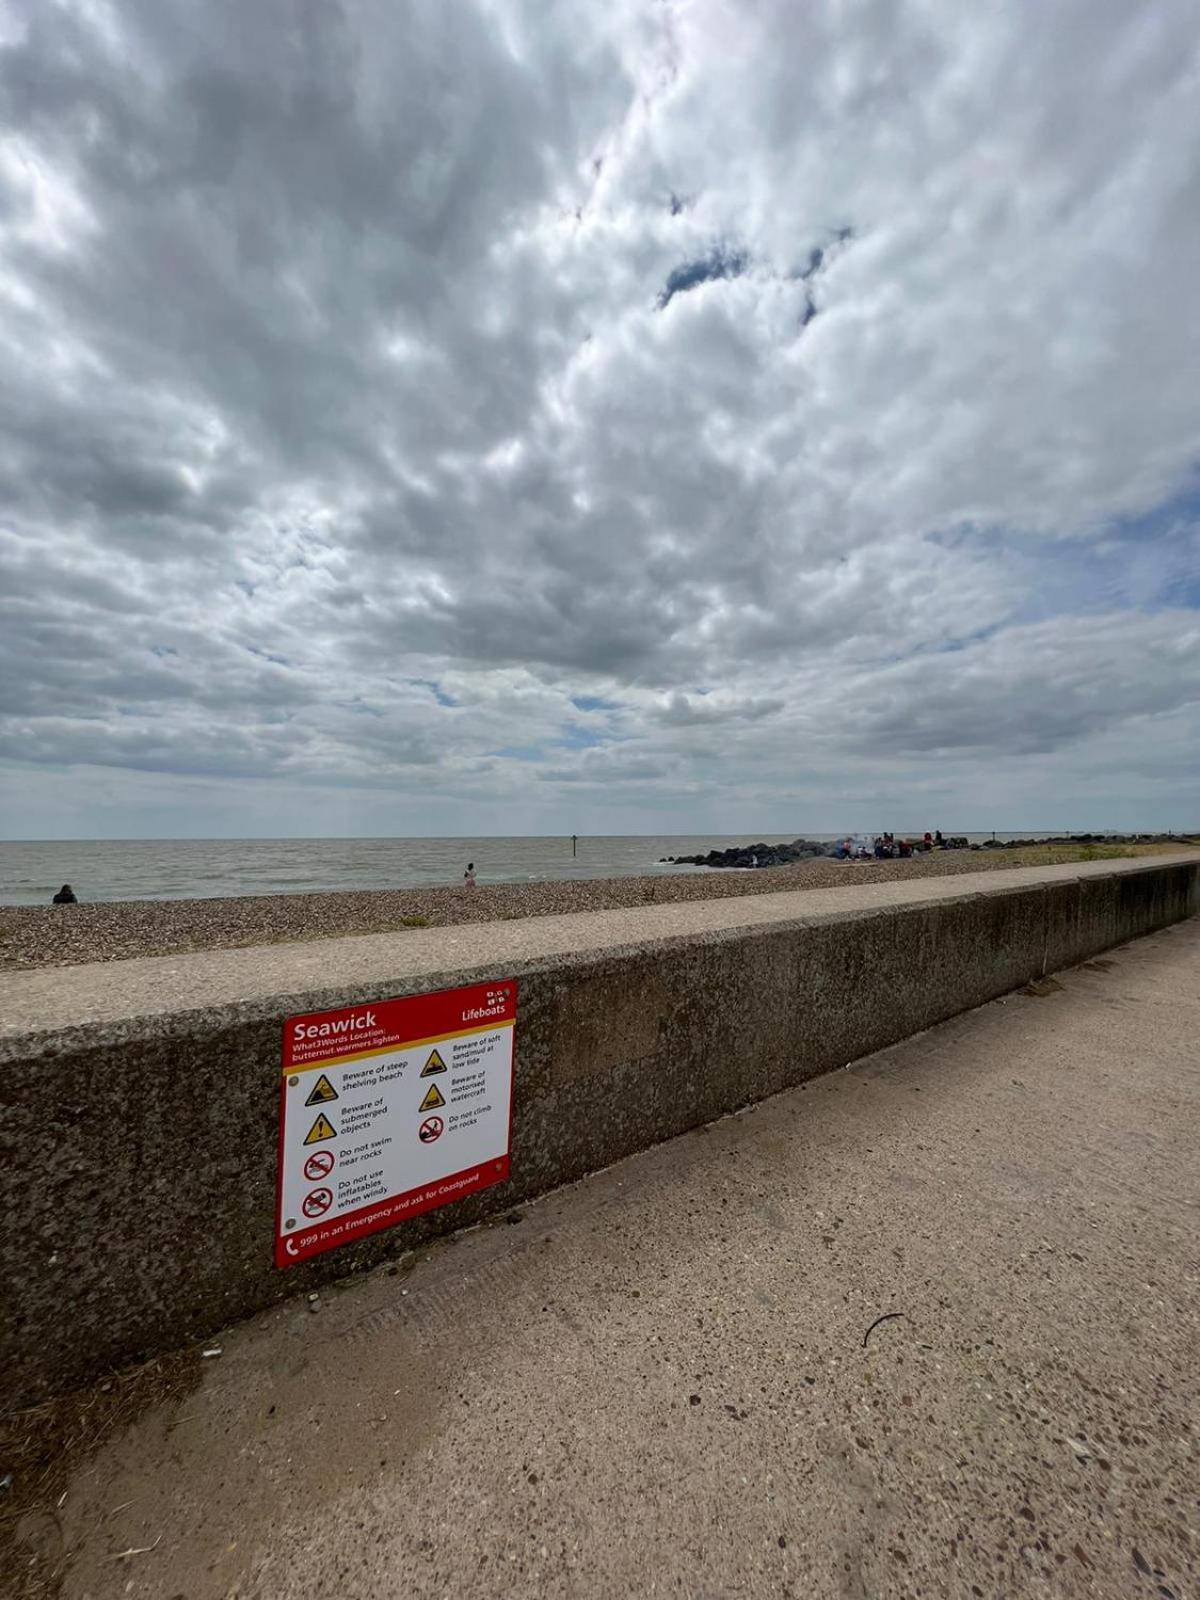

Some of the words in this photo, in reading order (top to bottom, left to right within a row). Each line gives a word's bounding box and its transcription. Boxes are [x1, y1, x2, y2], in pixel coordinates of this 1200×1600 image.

[462, 1005, 505, 1021] Lifeboats
[294, 1011, 376, 1040] Seawick
[293, 1035, 348, 1052] What3Words
[453, 1041, 478, 1051] Beware
[479, 1038, 487, 1046] of
[343, 1069, 374, 1081] Beware
[375, 1064, 384, 1073] of
[387, 1061, 408, 1071] steep
[452, 1074, 476, 1085] Beware
[478, 1070, 486, 1078] of
[342, 1078, 377, 1091] shelving
[379, 1070, 403, 1082] beach
[341, 1102, 372, 1115] Beware
[374, 1097, 383, 1106] of
[460, 1110, 473, 1119] not
[473, 1104, 492, 1115] climb
[341, 1106, 388, 1125] submerged
[459, 1118, 477, 1128] rocks
[340, 1121, 371, 1134] objects
[340, 1150, 352, 1158] Do
[354, 1144, 368, 1153] not
[370, 1137, 392, 1148] swim
[339, 1157, 358, 1167] near
[360, 1149, 382, 1160] rocks
[338, 1181, 351, 1189] Do
[353, 1175, 367, 1184] not
[369, 1170, 383, 1179] use
[338, 1180, 381, 1199] inflatables
[338, 1196, 361, 1208] when
[363, 1187, 388, 1199] windy
[300, 1232, 318, 1247] 999
[320, 1229, 330, 1240] in
[331, 1225, 343, 1235] an
[344, 1206, 392, 1230] Emergency
[393, 1199, 410, 1213] and
[410, 1194, 424, 1206] ask
[426, 1190, 437, 1199] for
[438, 1173, 479, 1194] Coastguard
